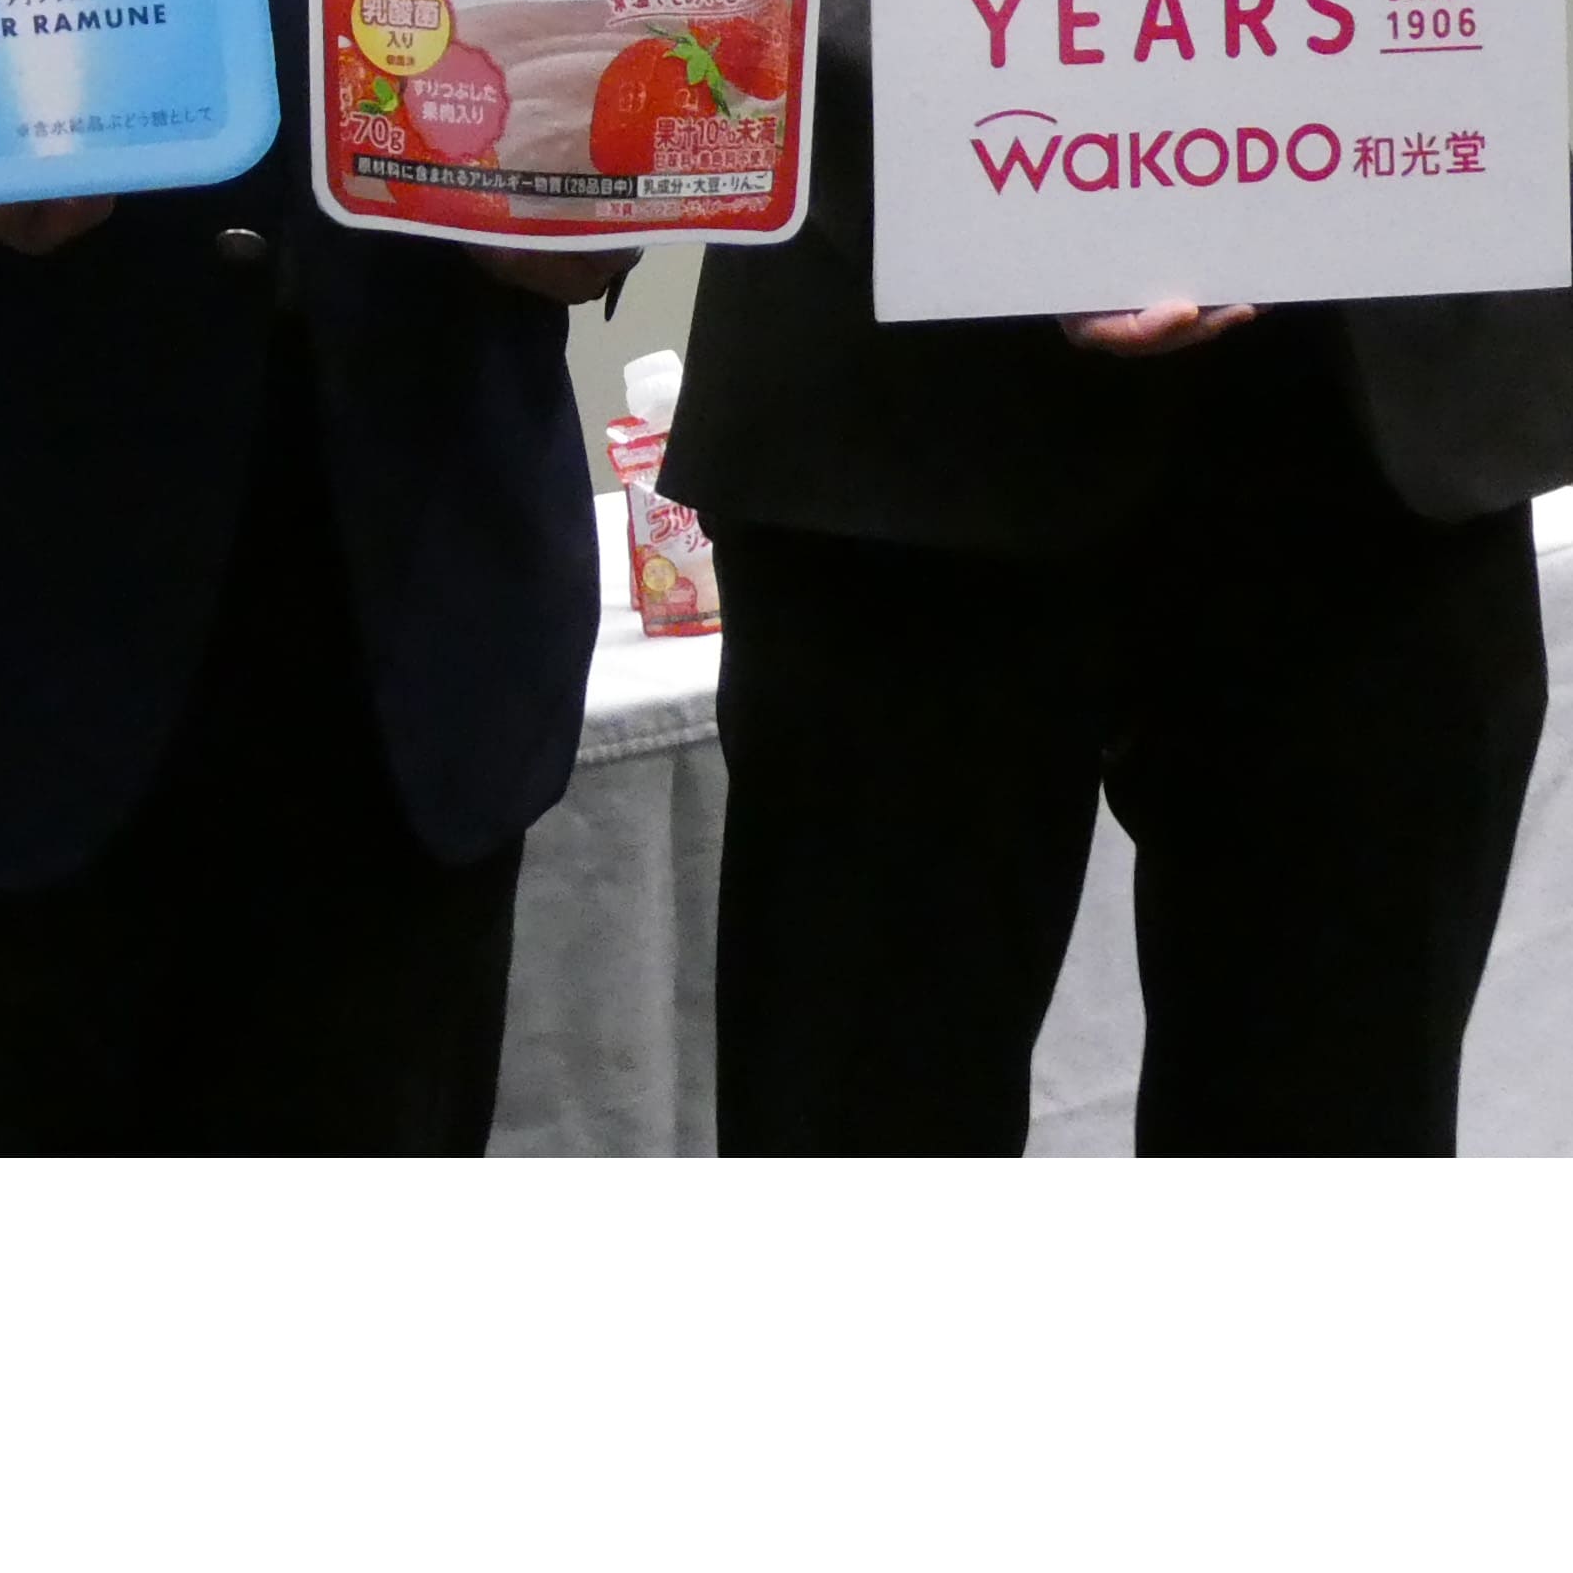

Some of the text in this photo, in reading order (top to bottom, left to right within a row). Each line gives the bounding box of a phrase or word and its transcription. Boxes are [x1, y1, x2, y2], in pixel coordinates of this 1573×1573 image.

[32, 3, 168, 36] RAMUNE
[1385, 6, 1478, 41] 1906
[386, 30, 414, 50] 入り
[412, 79, 497, 104] すりつぶした
[421, 101, 484, 126] 果肉入り
[353, 113, 405, 153] 70g
[656, 116, 778, 150] 果汁10%未満
[1352, 129, 1487, 179] 和光堂
[642, 172, 768, 195] 乳成分・大豆・りんご
